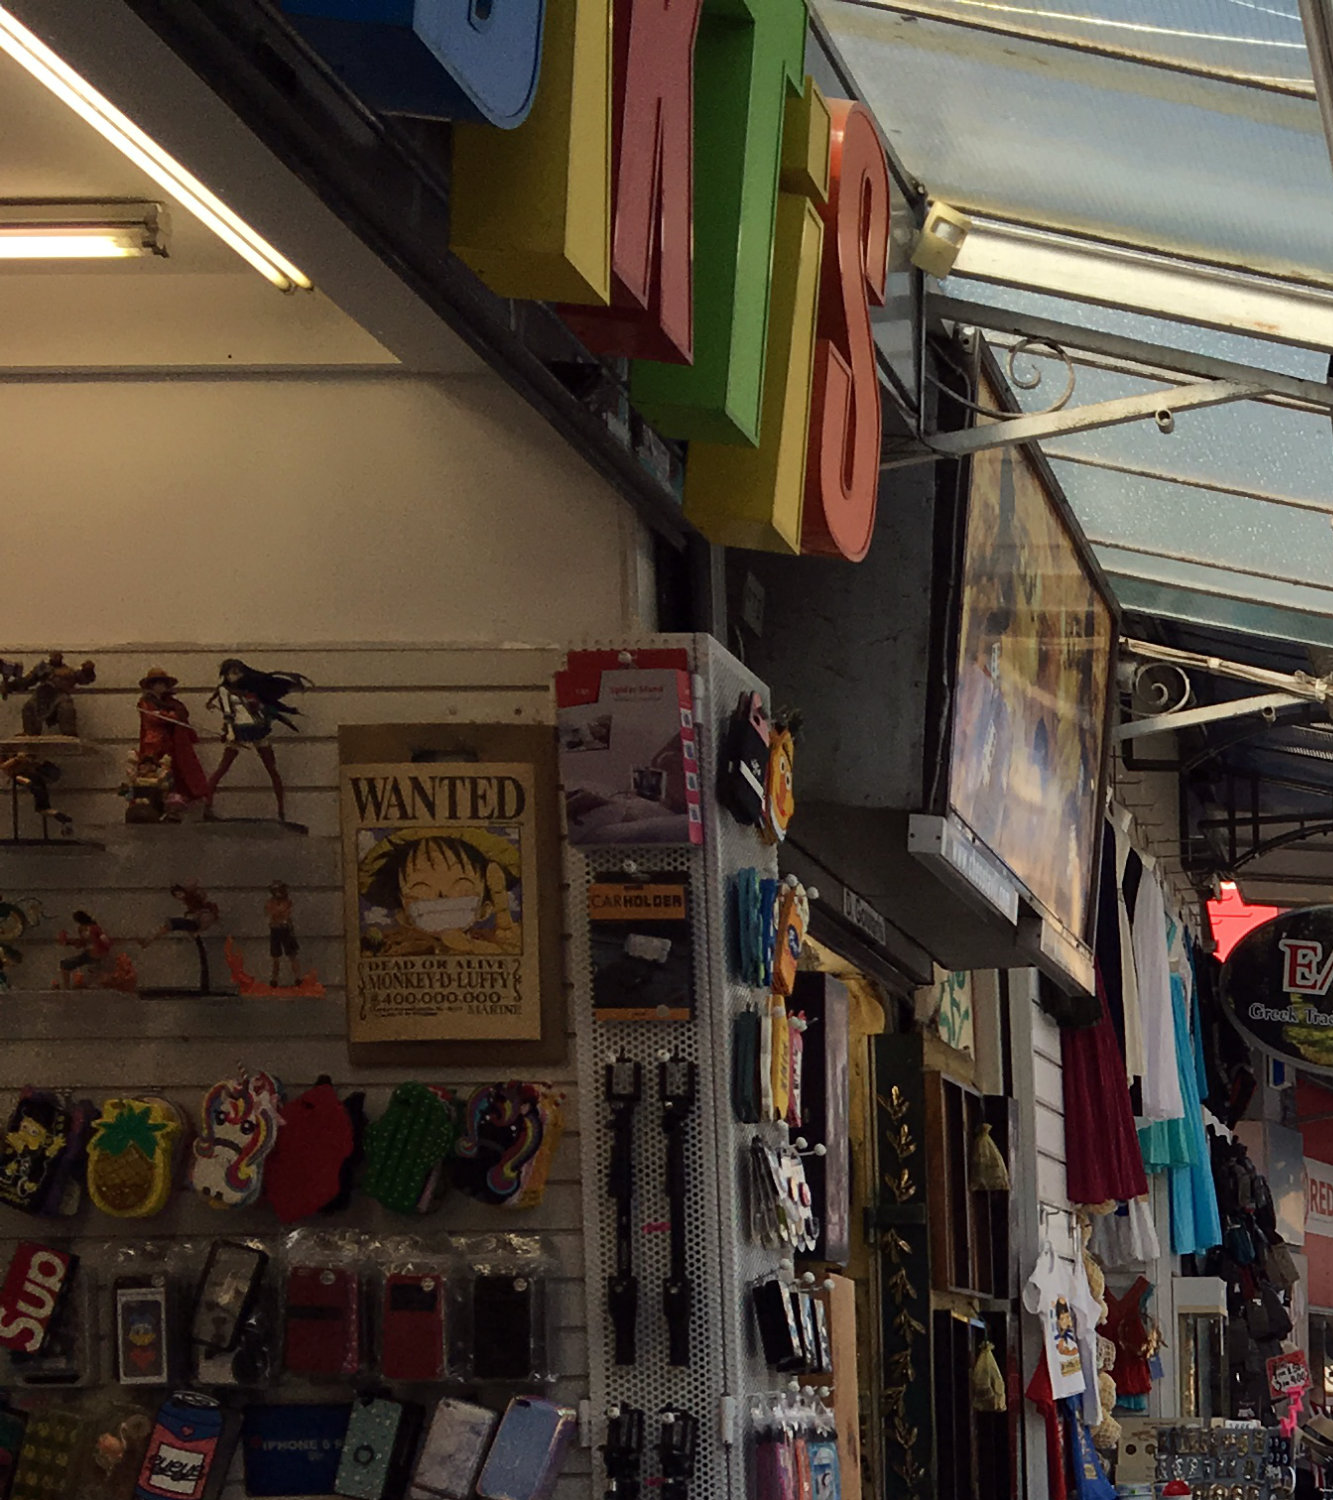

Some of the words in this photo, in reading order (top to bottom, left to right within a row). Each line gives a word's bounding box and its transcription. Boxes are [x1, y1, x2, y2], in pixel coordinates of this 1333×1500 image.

[350, 775, 527, 823] WANTED
[367, 958, 416, 972] DEAD
[421, 959, 448, 972] OR
[1249, 1002, 1300, 1024] Greek
